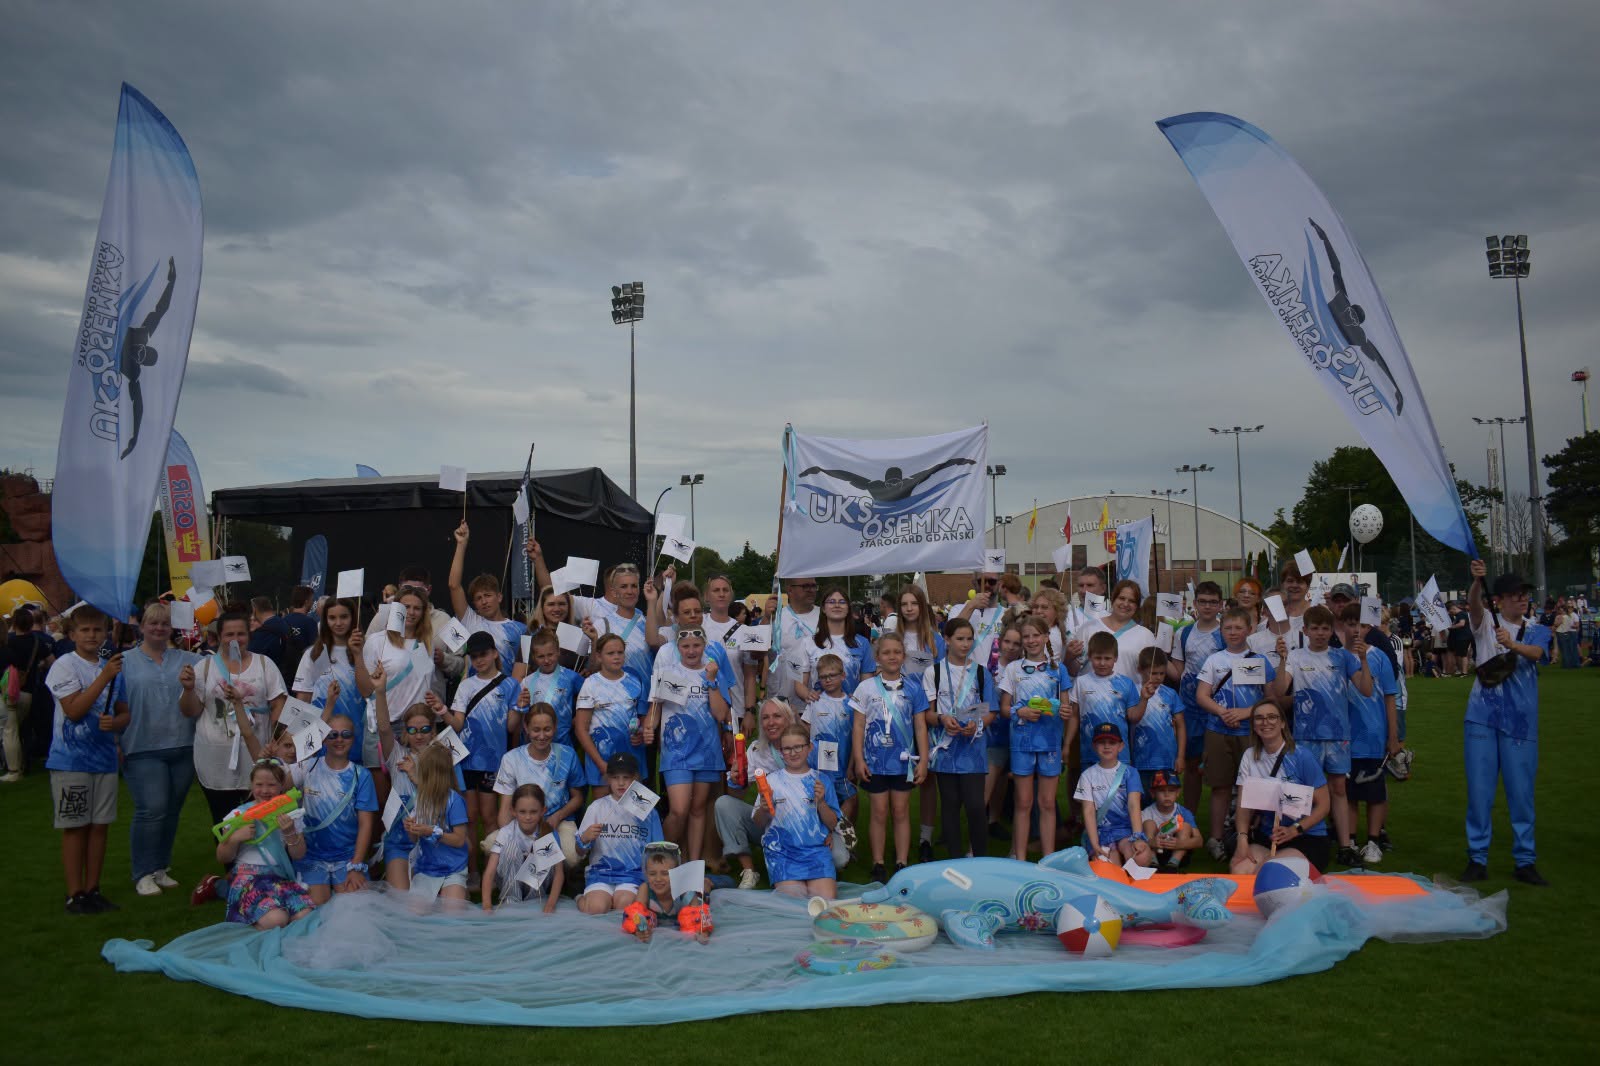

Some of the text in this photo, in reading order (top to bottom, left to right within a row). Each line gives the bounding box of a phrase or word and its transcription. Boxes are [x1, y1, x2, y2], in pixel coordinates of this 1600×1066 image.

[809, 493, 874, 524] UKS
[860, 534, 923, 548] STAROGARD
[62, 787, 88, 801] NEXT
[609, 823, 649, 838] VOSS
